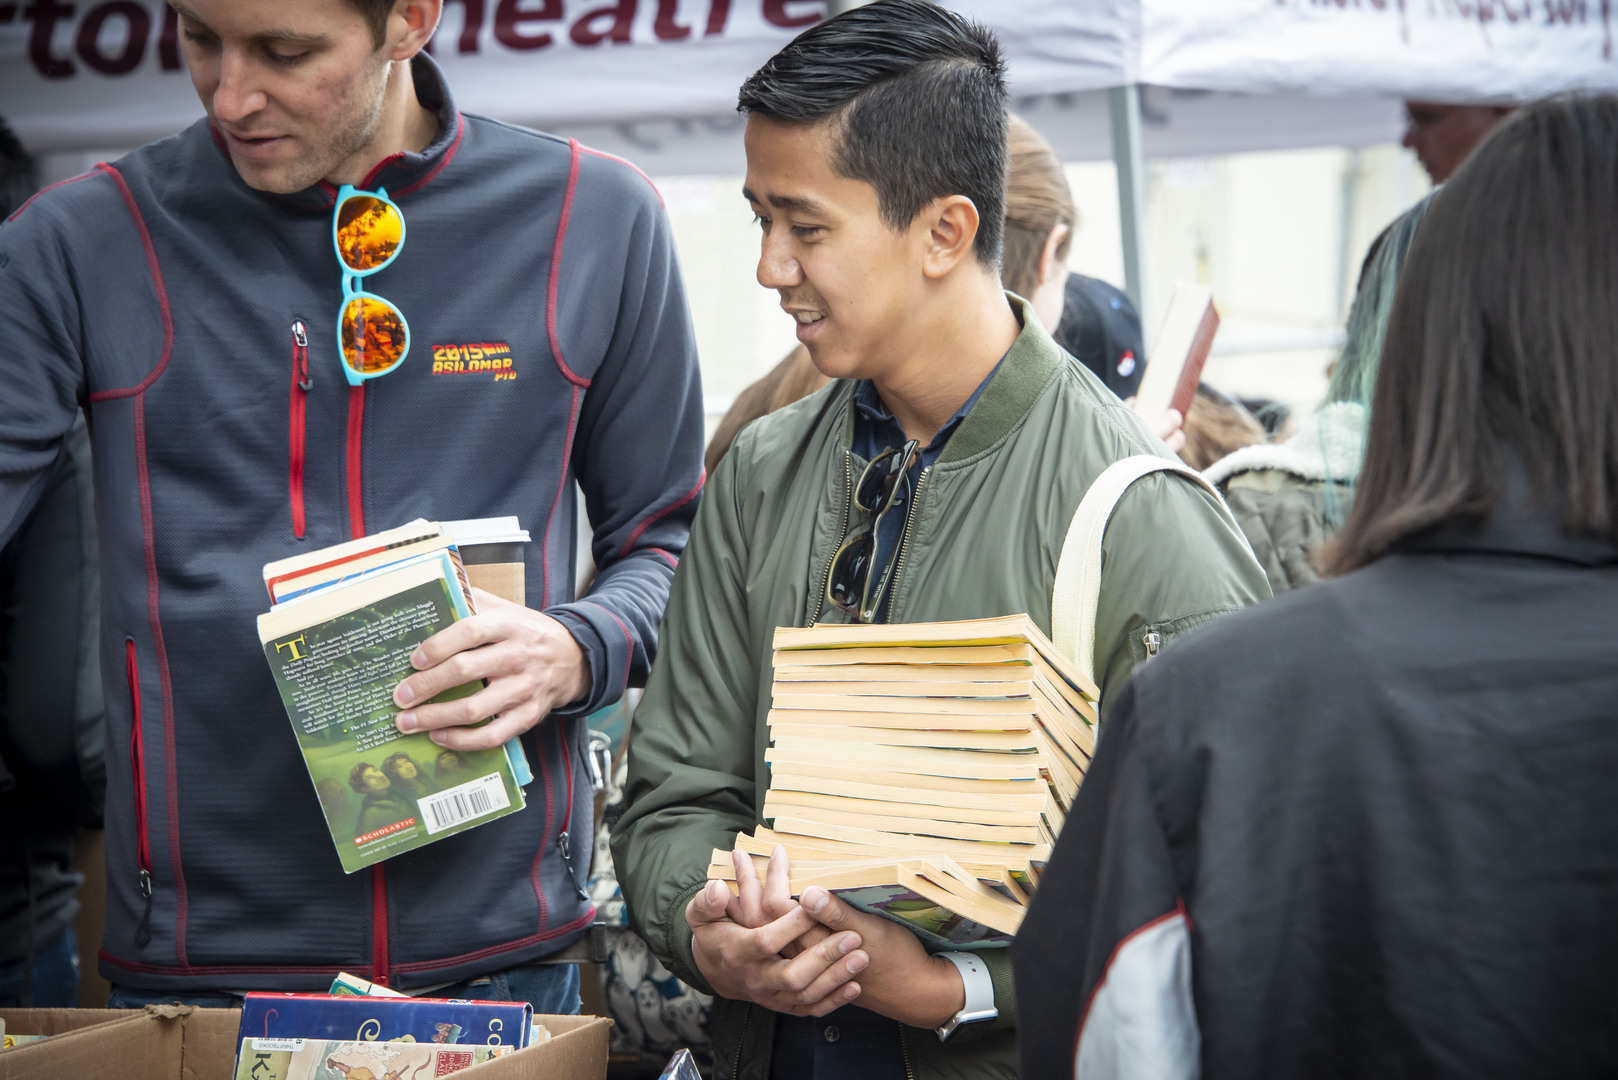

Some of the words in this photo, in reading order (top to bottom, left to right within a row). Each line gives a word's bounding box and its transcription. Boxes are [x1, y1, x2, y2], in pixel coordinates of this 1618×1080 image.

[431, 344, 484, 361] 2015
[431, 358, 513, 375] ASILOMAR
[363, 818, 414, 841] SCHOLASTIC
